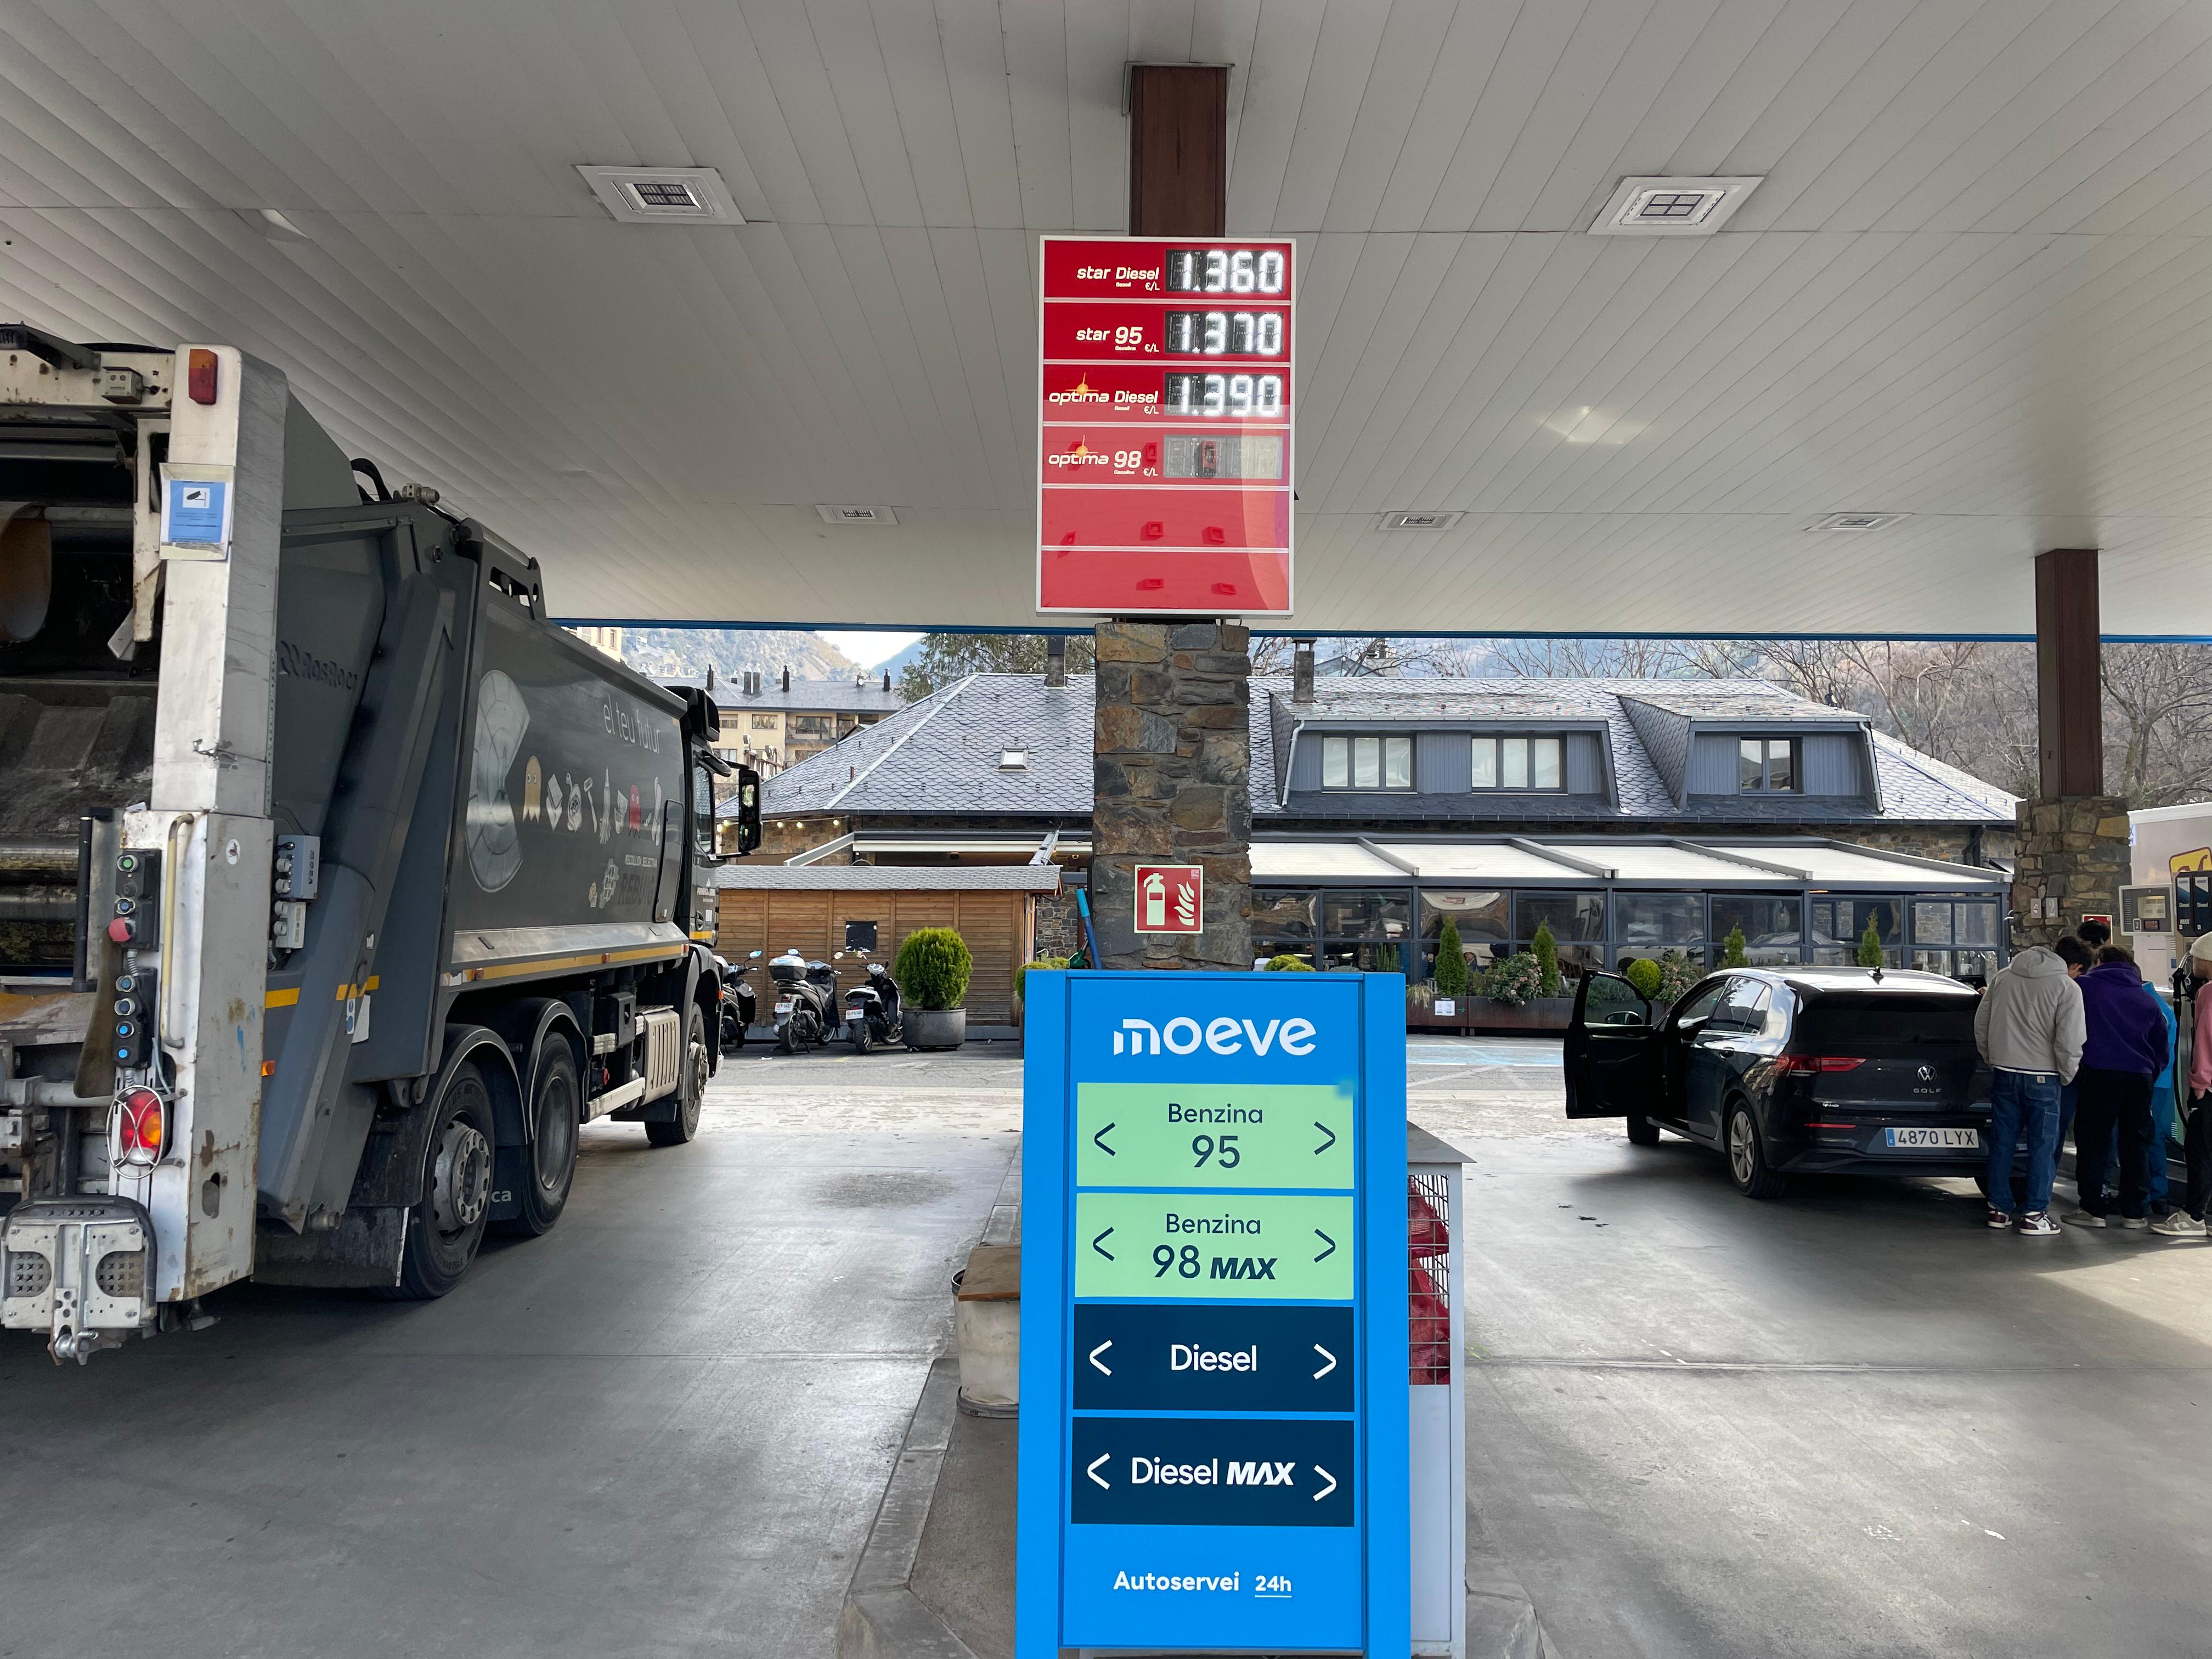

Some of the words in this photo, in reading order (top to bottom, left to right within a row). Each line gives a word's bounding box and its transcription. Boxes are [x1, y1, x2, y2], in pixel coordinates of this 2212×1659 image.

[1077, 266, 1111, 279] star
[1115, 267, 1160, 280] Diesel
[1182, 251, 1284, 292] 1.360
[1145, 281, 1160, 291] €/L
[1076, 328, 1110, 341] star
[1115, 326, 1143, 345] 95
[1182, 312, 1283, 354] 1.370
[1144, 343, 1160, 352] €/L
[1049, 392, 1110, 406] optima
[1114, 391, 1159, 403] Diesel
[1181, 375, 1282, 417] 1.390
[1144, 405, 1159, 415] €/L
[1048, 454, 1109, 468] optima
[1114, 450, 1142, 468] 98
[1143, 467, 1158, 477] €/L
[603, 693, 616, 735] el
[615, 701, 635, 743] teu
[636, 709, 659, 753] futur
[2049, 899, 2055, 917] 2
[1113, 1016, 1317, 1056] moeve
[1168, 1103, 1263, 1124] Benzina
[1898, 1131, 1938, 1144] 4870
[1944, 1131, 1974, 1146] LYX
[1192, 1134, 1240, 1169] 95
[1166, 1213, 1261, 1234] Benzina
[1153, 1244, 1201, 1279] 98
[1210, 1257, 1278, 1279] MAX
[1171, 1344, 1257, 1372] Diesel
[1131, 1457, 1218, 1485] Diesel
[1226, 1462, 1295, 1486] MAX
[1113, 1571, 1239, 1592] Autoservei
[1255, 1575, 1291, 1592] 24h
